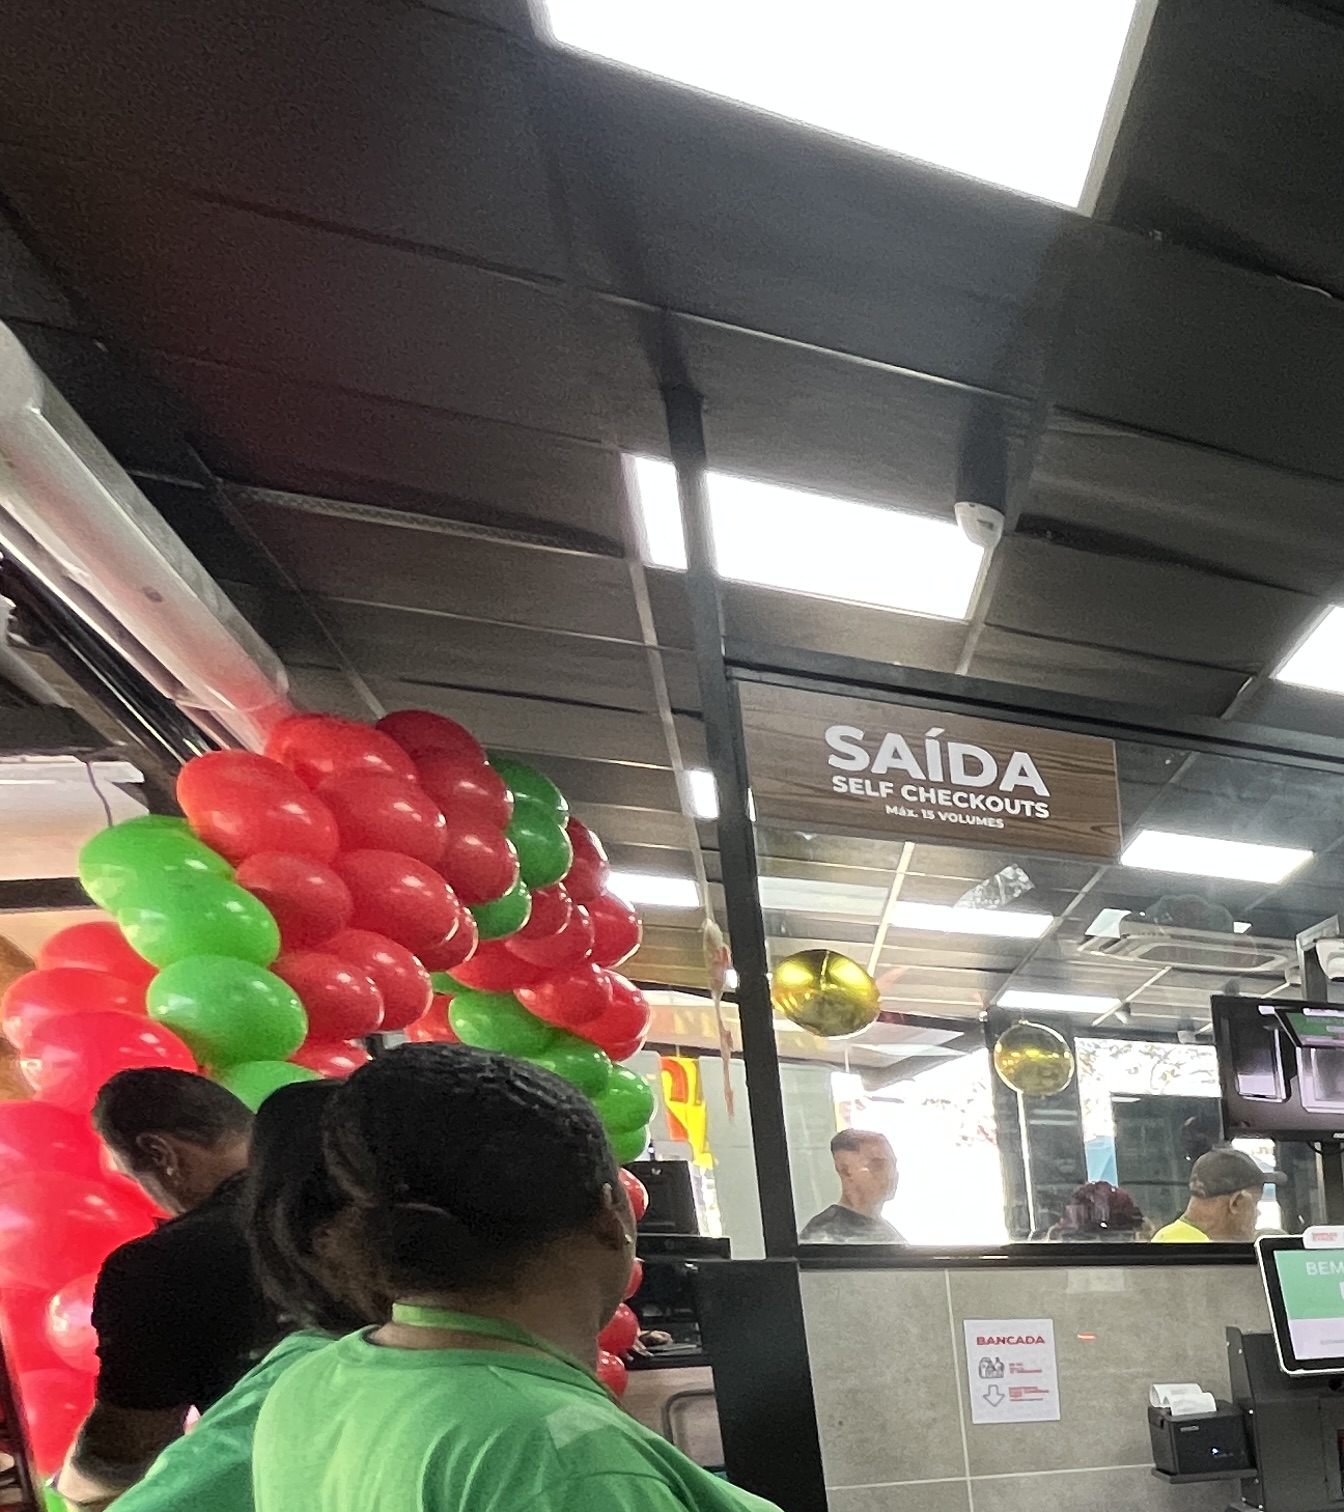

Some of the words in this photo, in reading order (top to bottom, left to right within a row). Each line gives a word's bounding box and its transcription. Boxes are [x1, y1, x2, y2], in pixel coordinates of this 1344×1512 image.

[824, 724, 1051, 797] SAÍDA
[832, 775, 895, 798] SELF
[901, 784, 1050, 819] CHECKOUTS
[885, 804, 918, 818] Máx.
[921, 809, 935, 820] 15
[938, 811, 1005, 828] VOLUMES
[976, 1335, 1046, 1346] BANCADA
